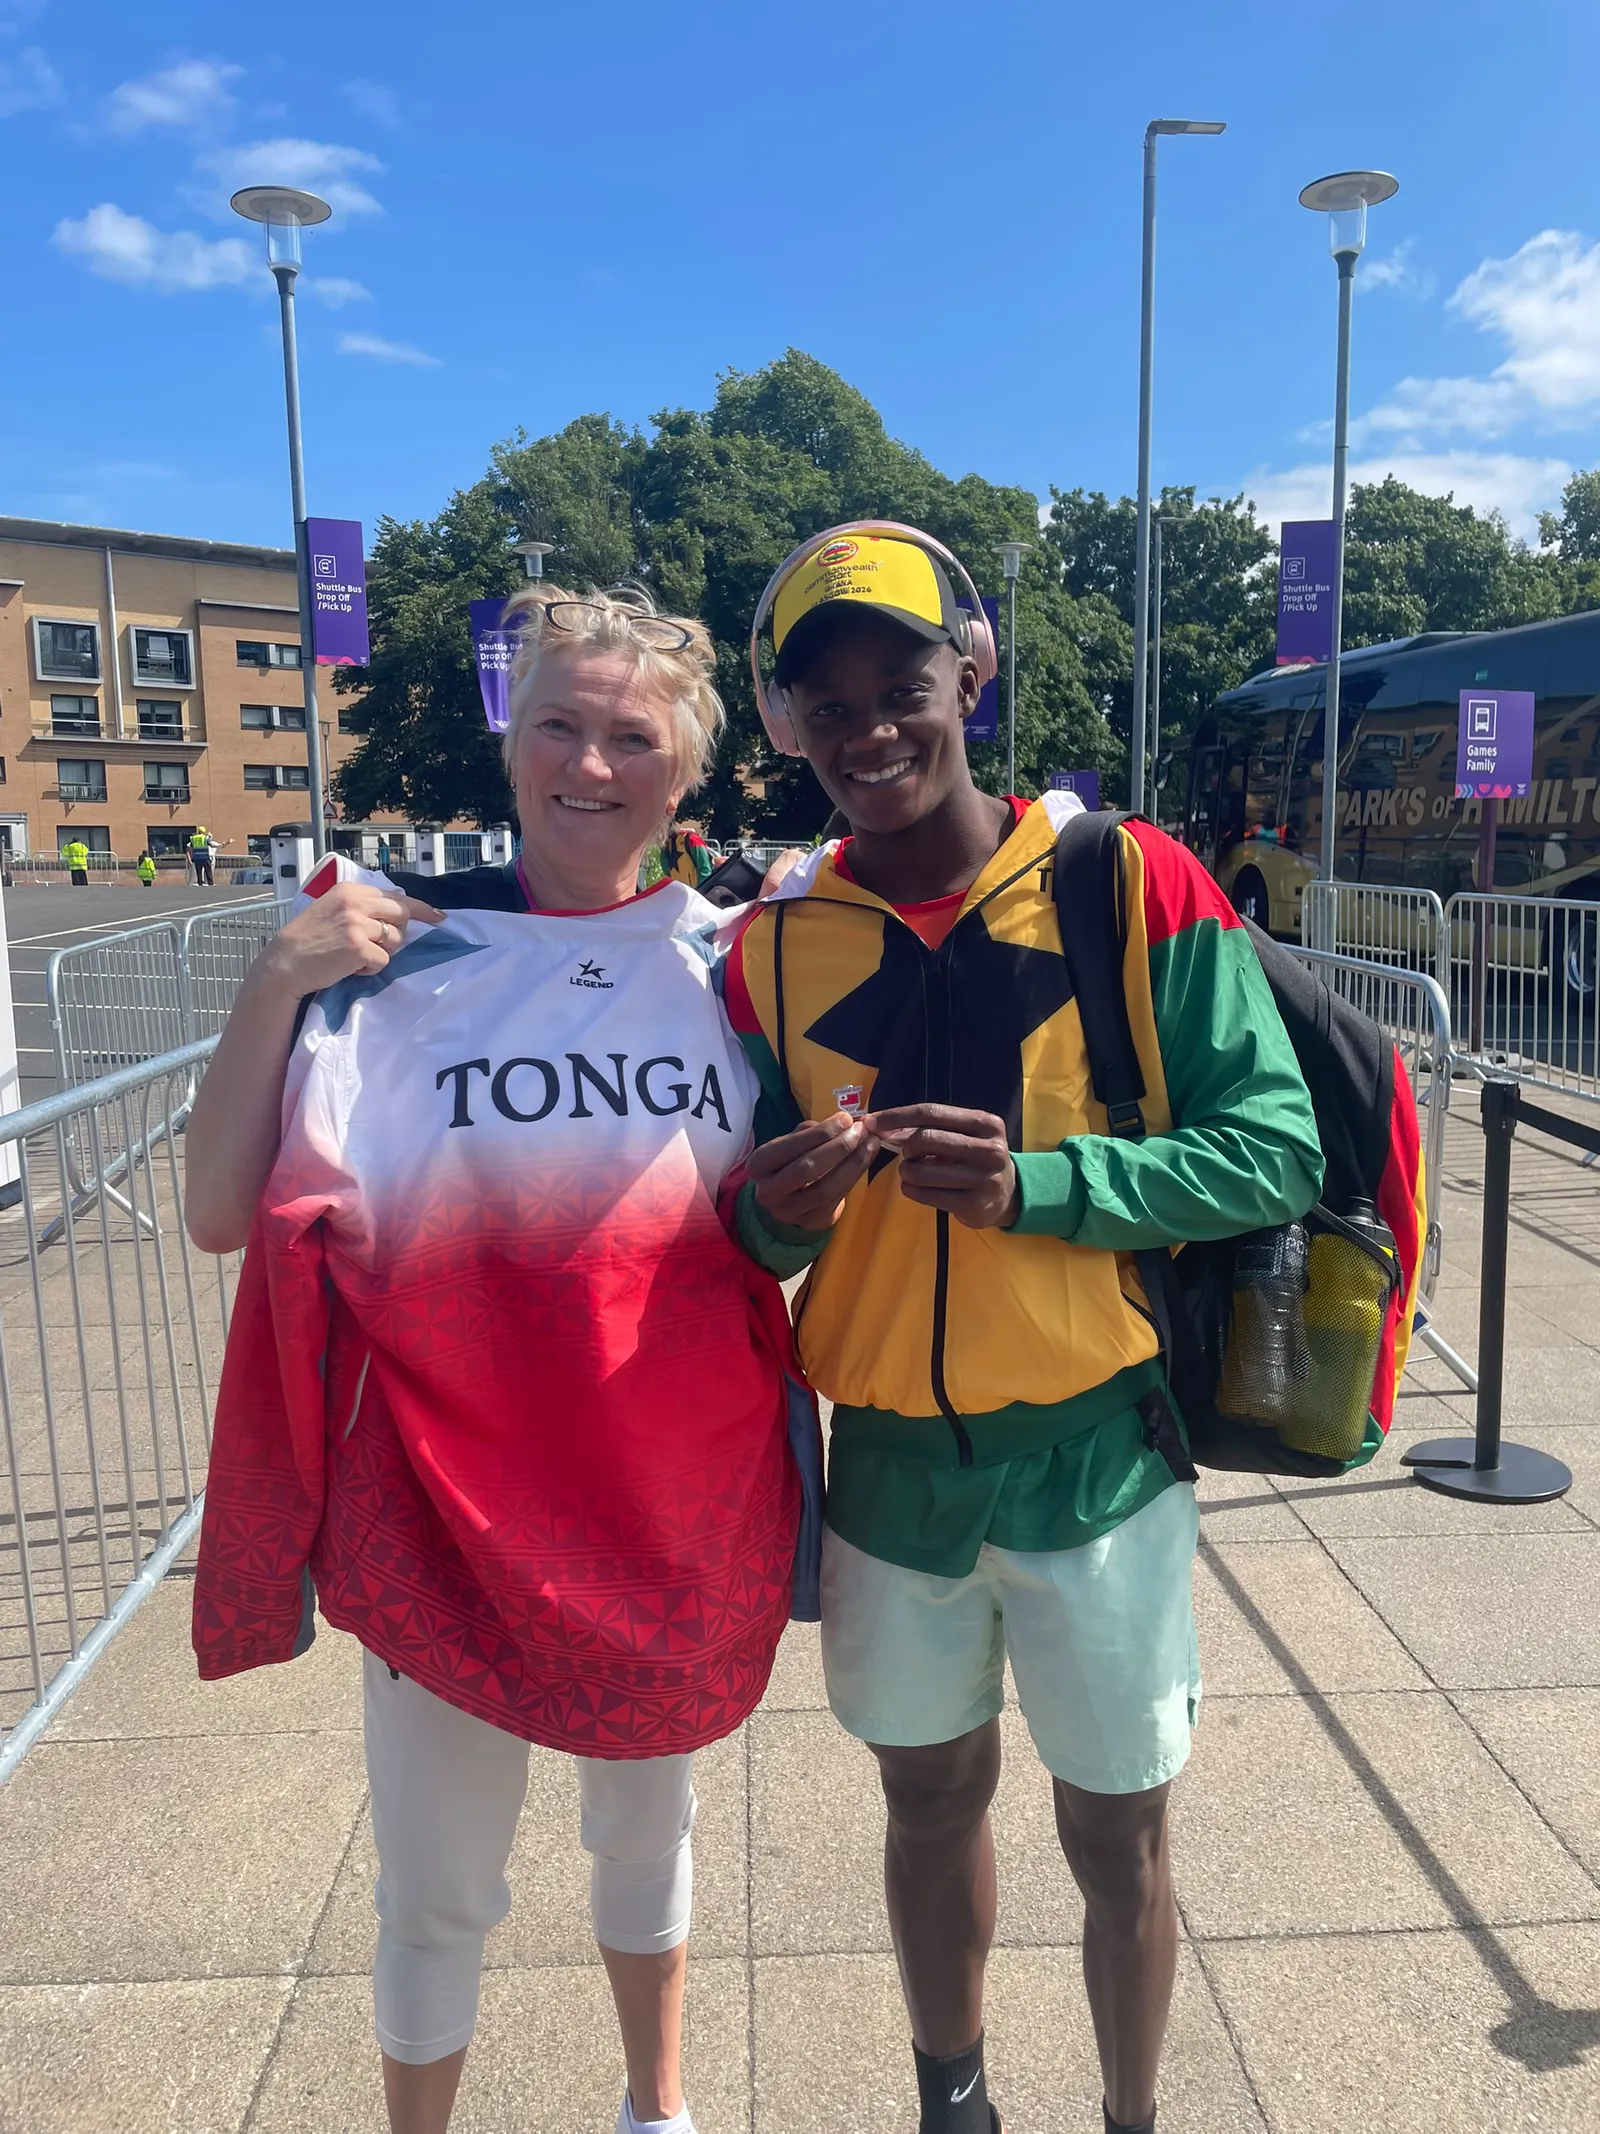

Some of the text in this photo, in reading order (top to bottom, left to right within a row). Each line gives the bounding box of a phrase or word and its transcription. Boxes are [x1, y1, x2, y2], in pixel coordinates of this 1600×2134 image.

[825, 571, 852, 584] sport
[316, 583, 362, 593] Shuttle Bus
[1283, 584, 1313, 593] Shuttle
[317, 592, 350, 602] Drop Off
[1283, 593, 1317, 603] Drop Off
[318, 601, 352, 612] /Pick Up
[1283, 603, 1318, 612] /Pick Up
[479, 643, 508, 651] Shuttle
[480, 653, 500, 661] Drop
[1467, 745, 1497, 756] Games
[1466, 759, 1496, 774] Family
[570, 976, 614, 989] LEGEND
[436, 1053, 732, 1133] TONGA
